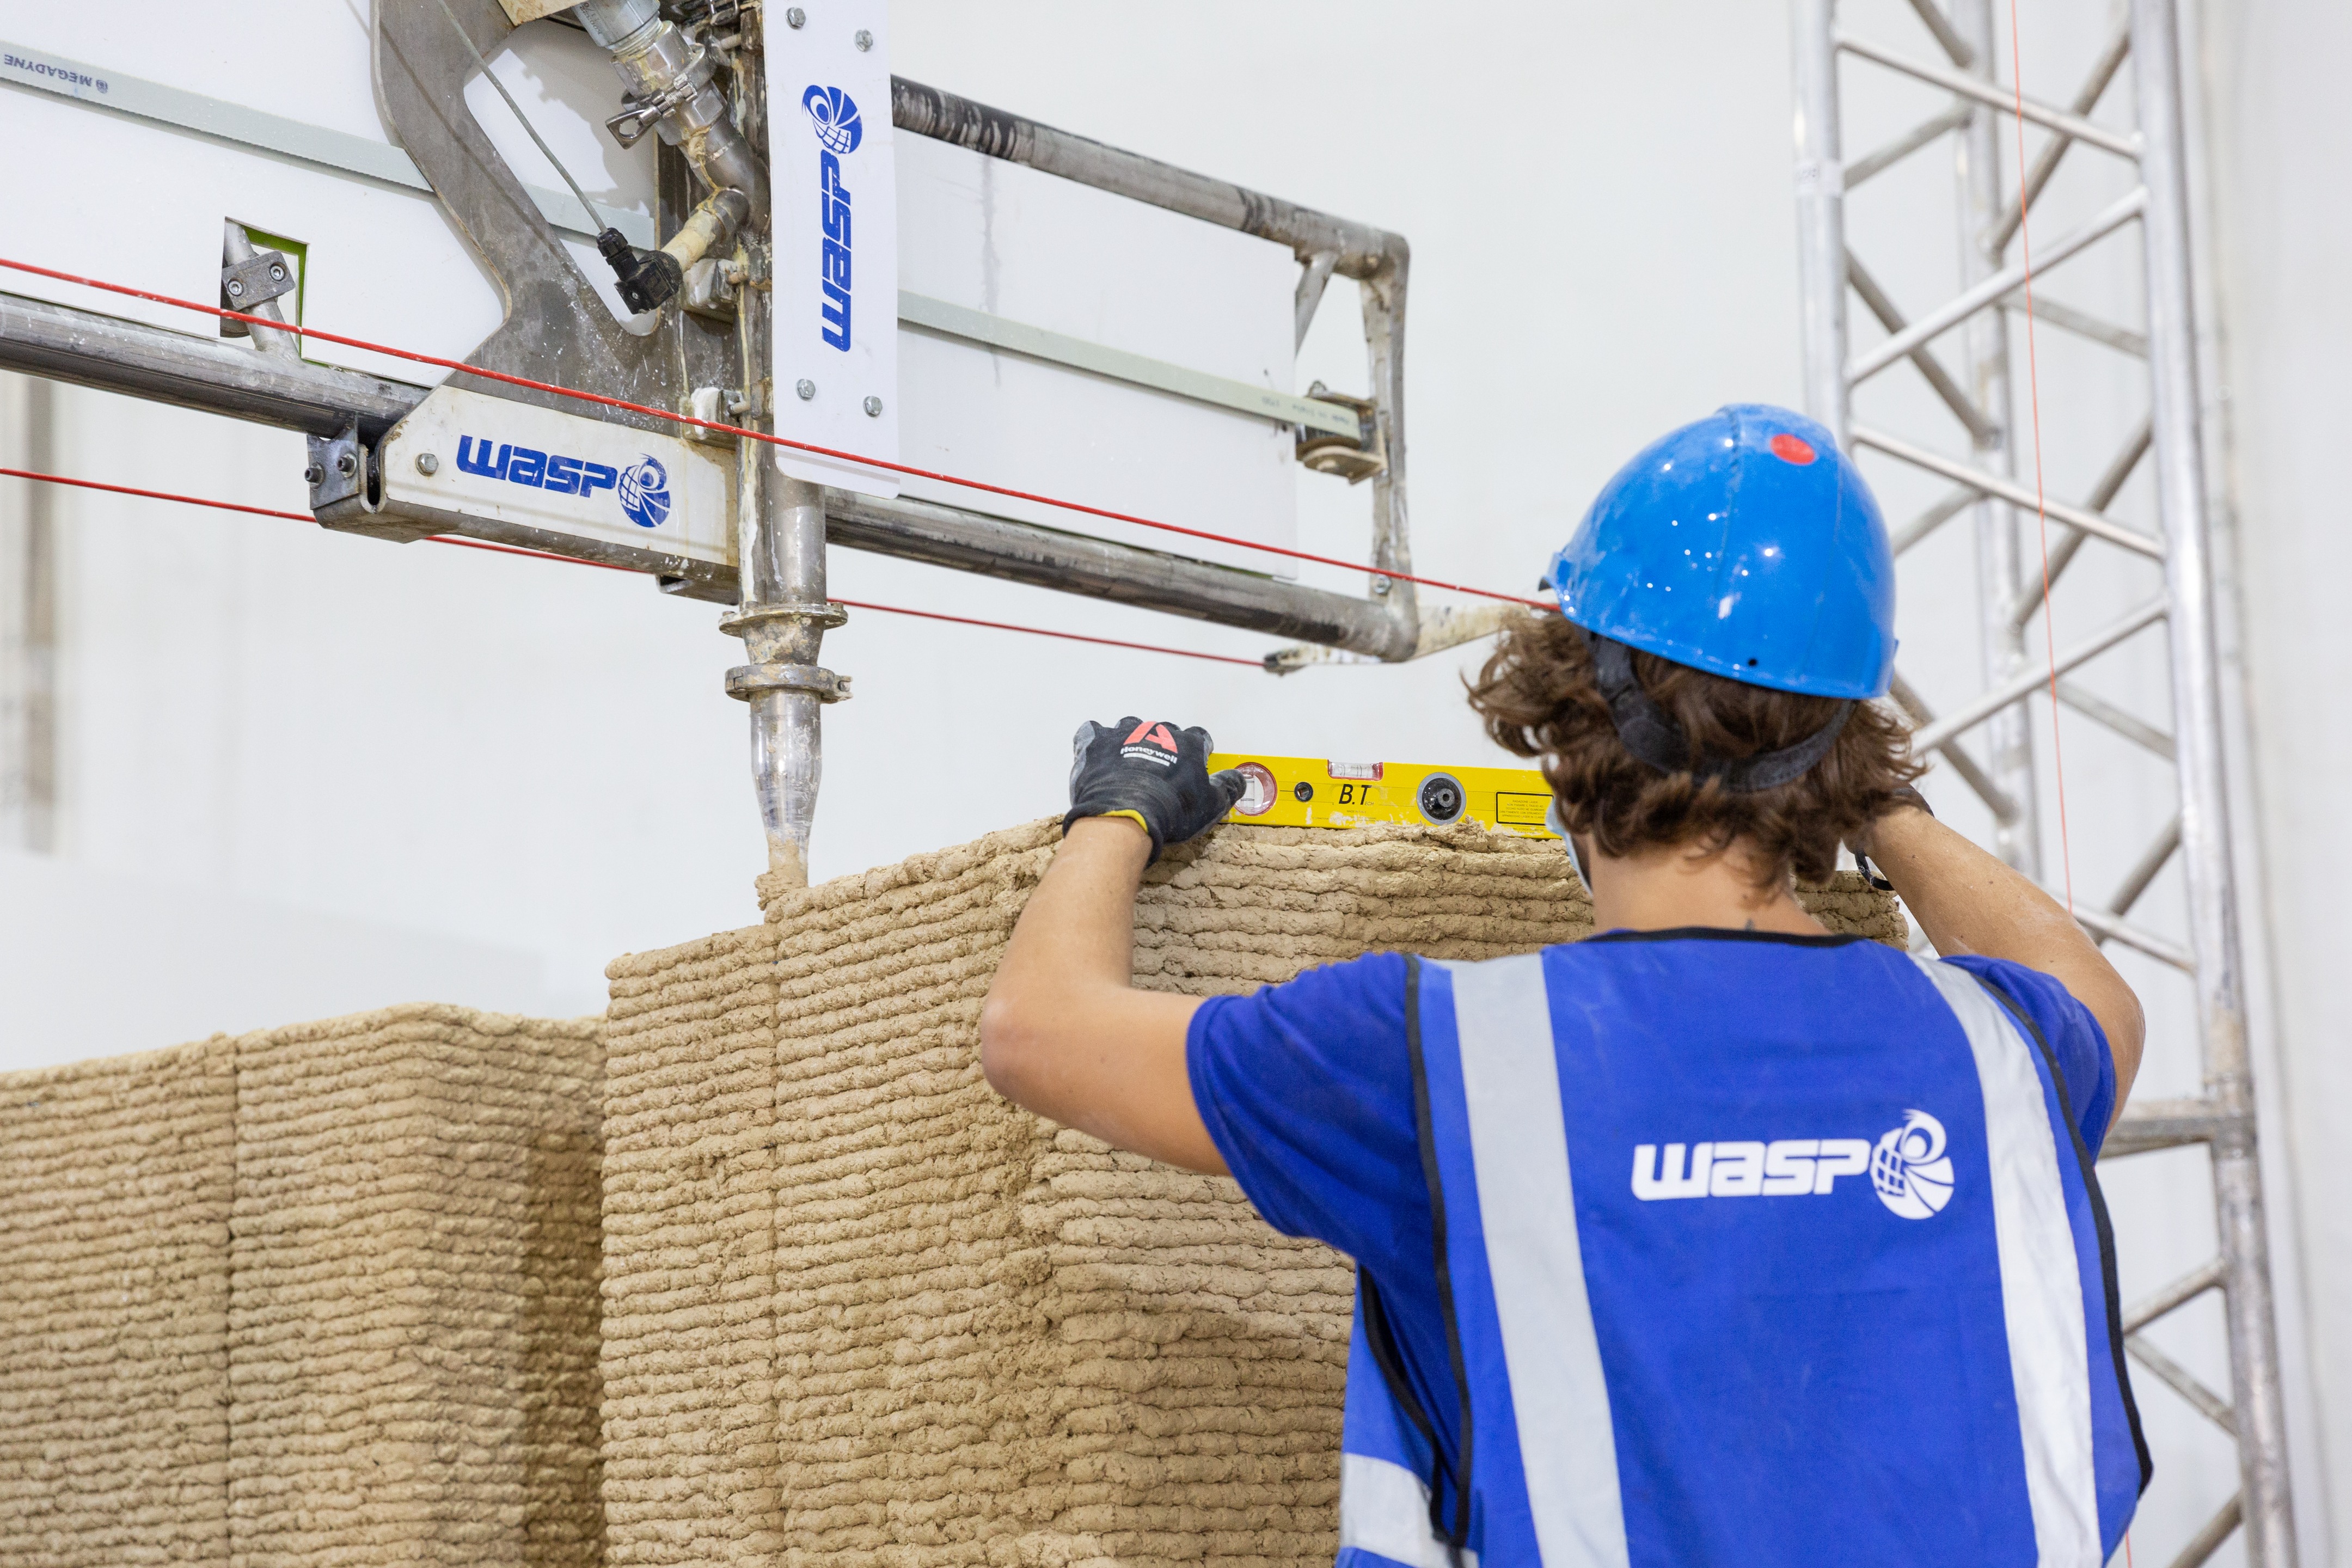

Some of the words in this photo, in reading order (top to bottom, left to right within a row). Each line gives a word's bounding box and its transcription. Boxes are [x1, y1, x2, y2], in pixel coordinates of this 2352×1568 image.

[4, 54, 93, 87] MEGADYNE
[820, 150, 852, 352] WASP
[457, 436, 617, 498] WASP
[1120, 746, 1178, 764] Honeywell
[1632, 1140, 1871, 1200] WASP
